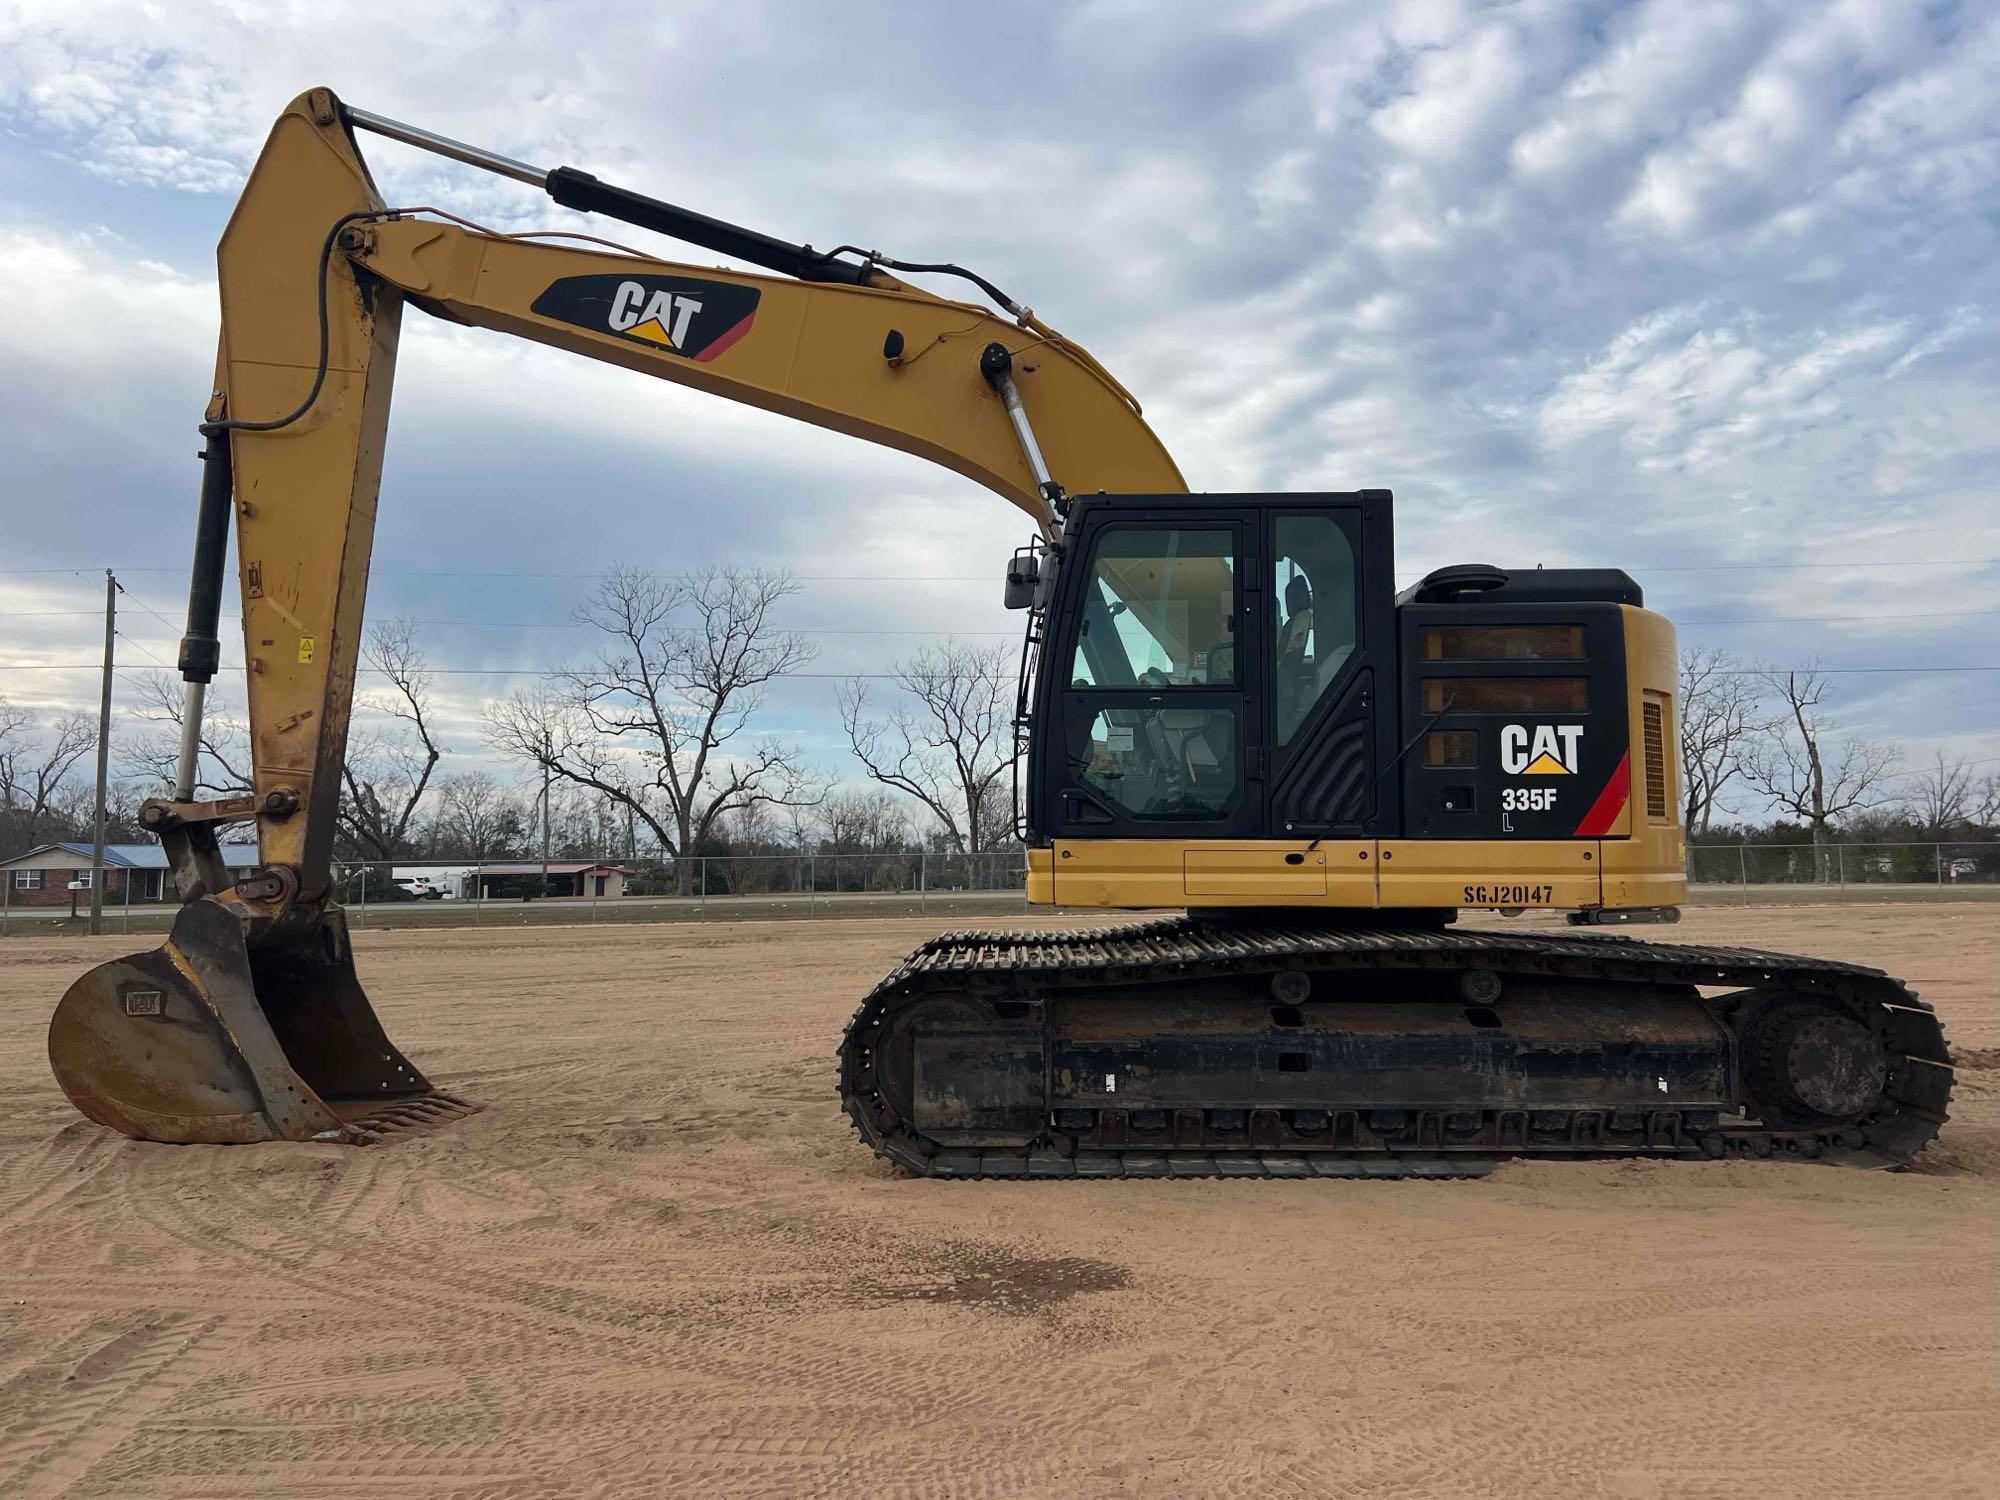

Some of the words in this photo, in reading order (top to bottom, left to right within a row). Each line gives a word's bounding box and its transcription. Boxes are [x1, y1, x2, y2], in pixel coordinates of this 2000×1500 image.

[608, 281, 703, 349] CAT
[1500, 724, 1584, 775] CAT
[1502, 788, 1557, 811] 335F
[1502, 813, 1514, 832] L
